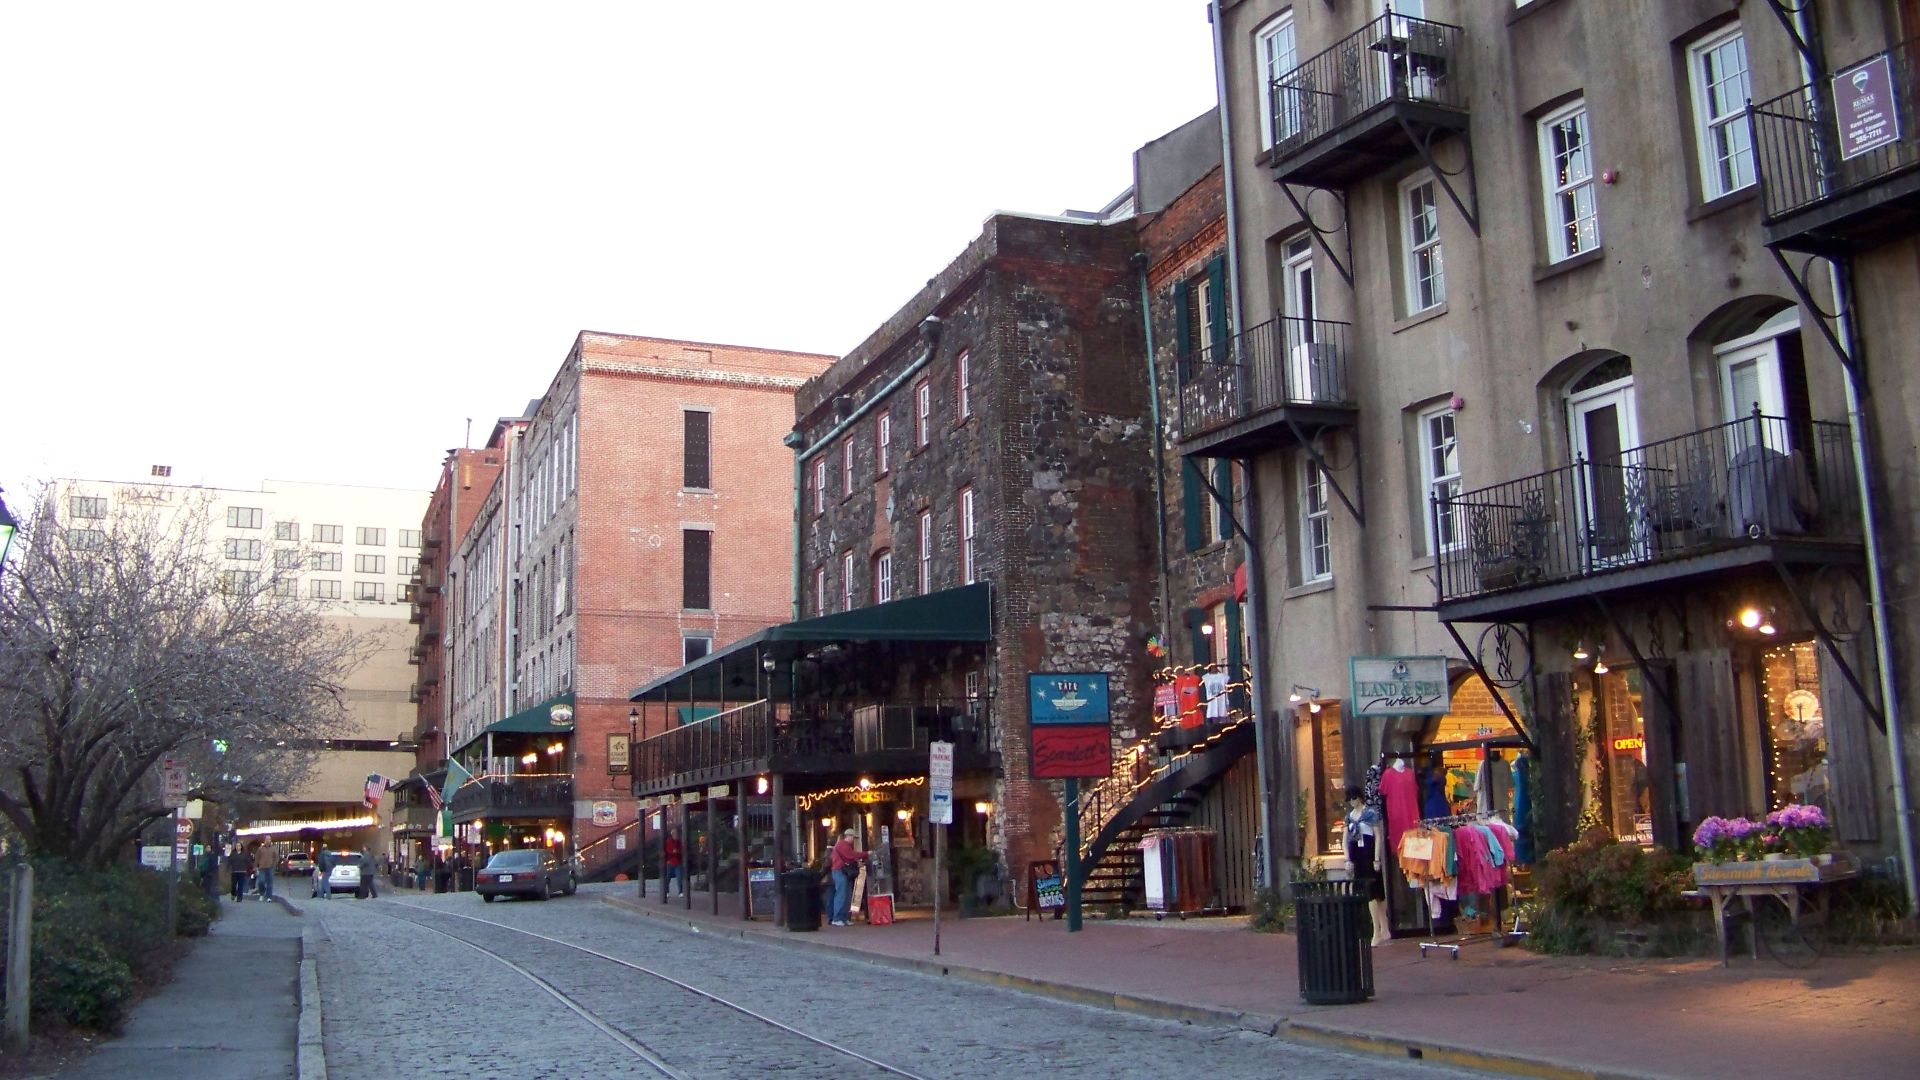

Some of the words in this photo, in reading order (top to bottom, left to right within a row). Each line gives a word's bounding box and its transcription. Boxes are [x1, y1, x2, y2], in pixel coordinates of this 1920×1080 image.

[1361, 681, 1397, 698] LAND
[1400, 681, 1410, 698] &
[1415, 681, 1441, 696] SEA
[1362, 695, 1442, 712] wear
[1614, 738, 1643, 750] OPEN
